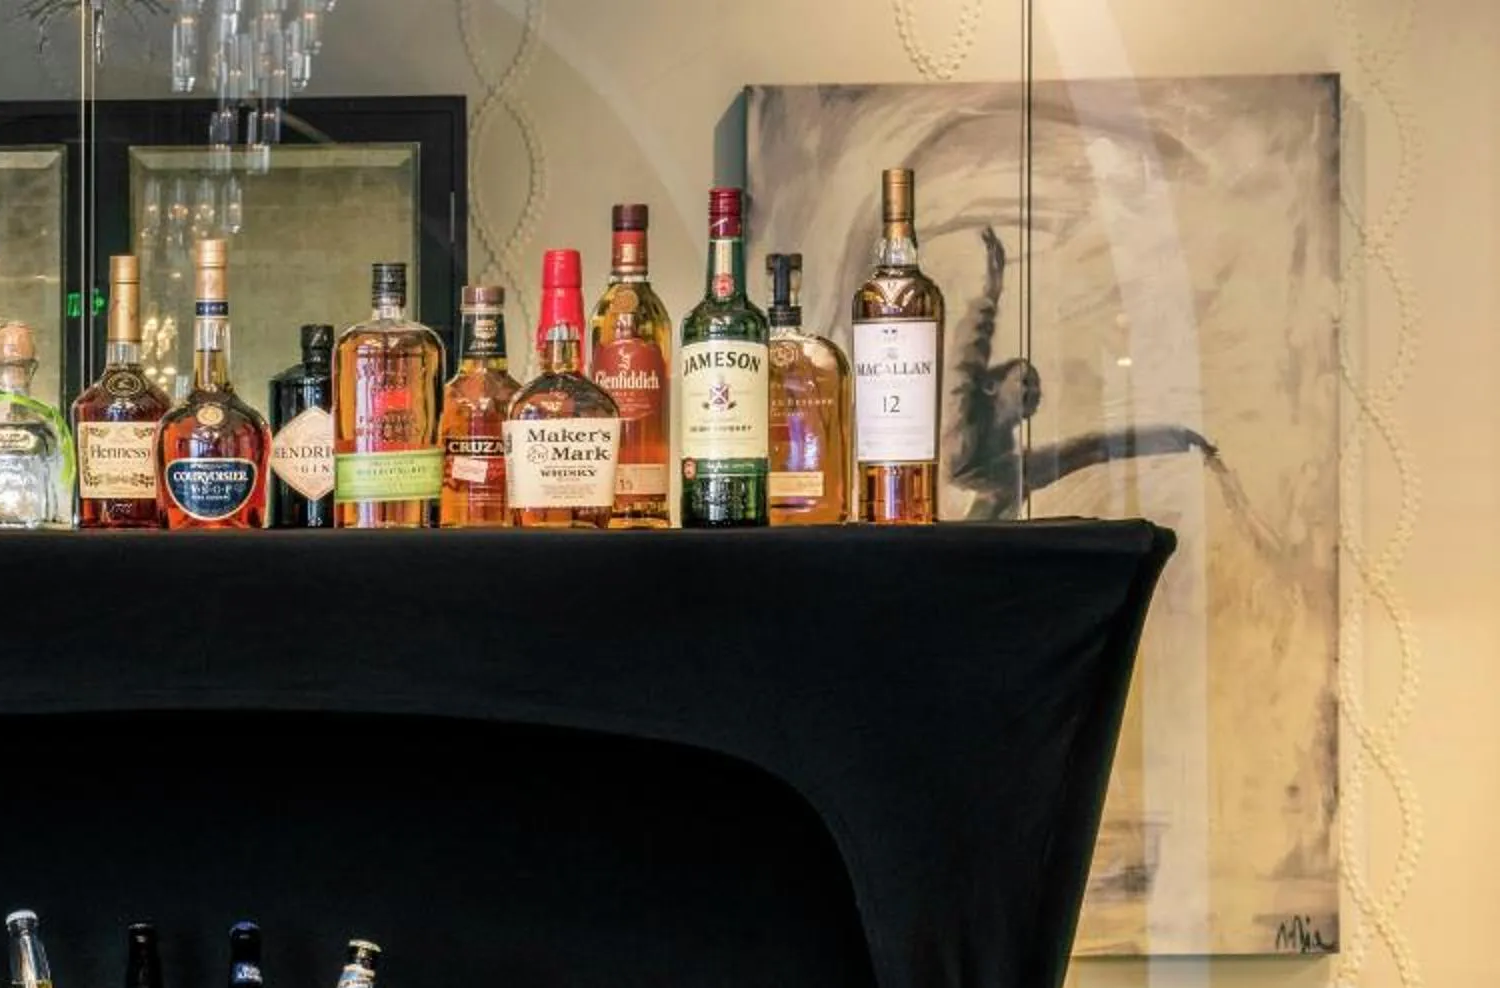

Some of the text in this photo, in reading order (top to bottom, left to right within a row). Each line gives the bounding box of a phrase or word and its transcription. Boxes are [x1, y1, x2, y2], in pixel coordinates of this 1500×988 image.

[683, 351, 761, 377] JAMESON
[882, 395, 901, 413] 12
[527, 428, 612, 443] Maker's
[91, 445, 152, 464] Hennessy
[551, 447, 611, 461] Mark
[541, 469, 598, 478] WHISKY
